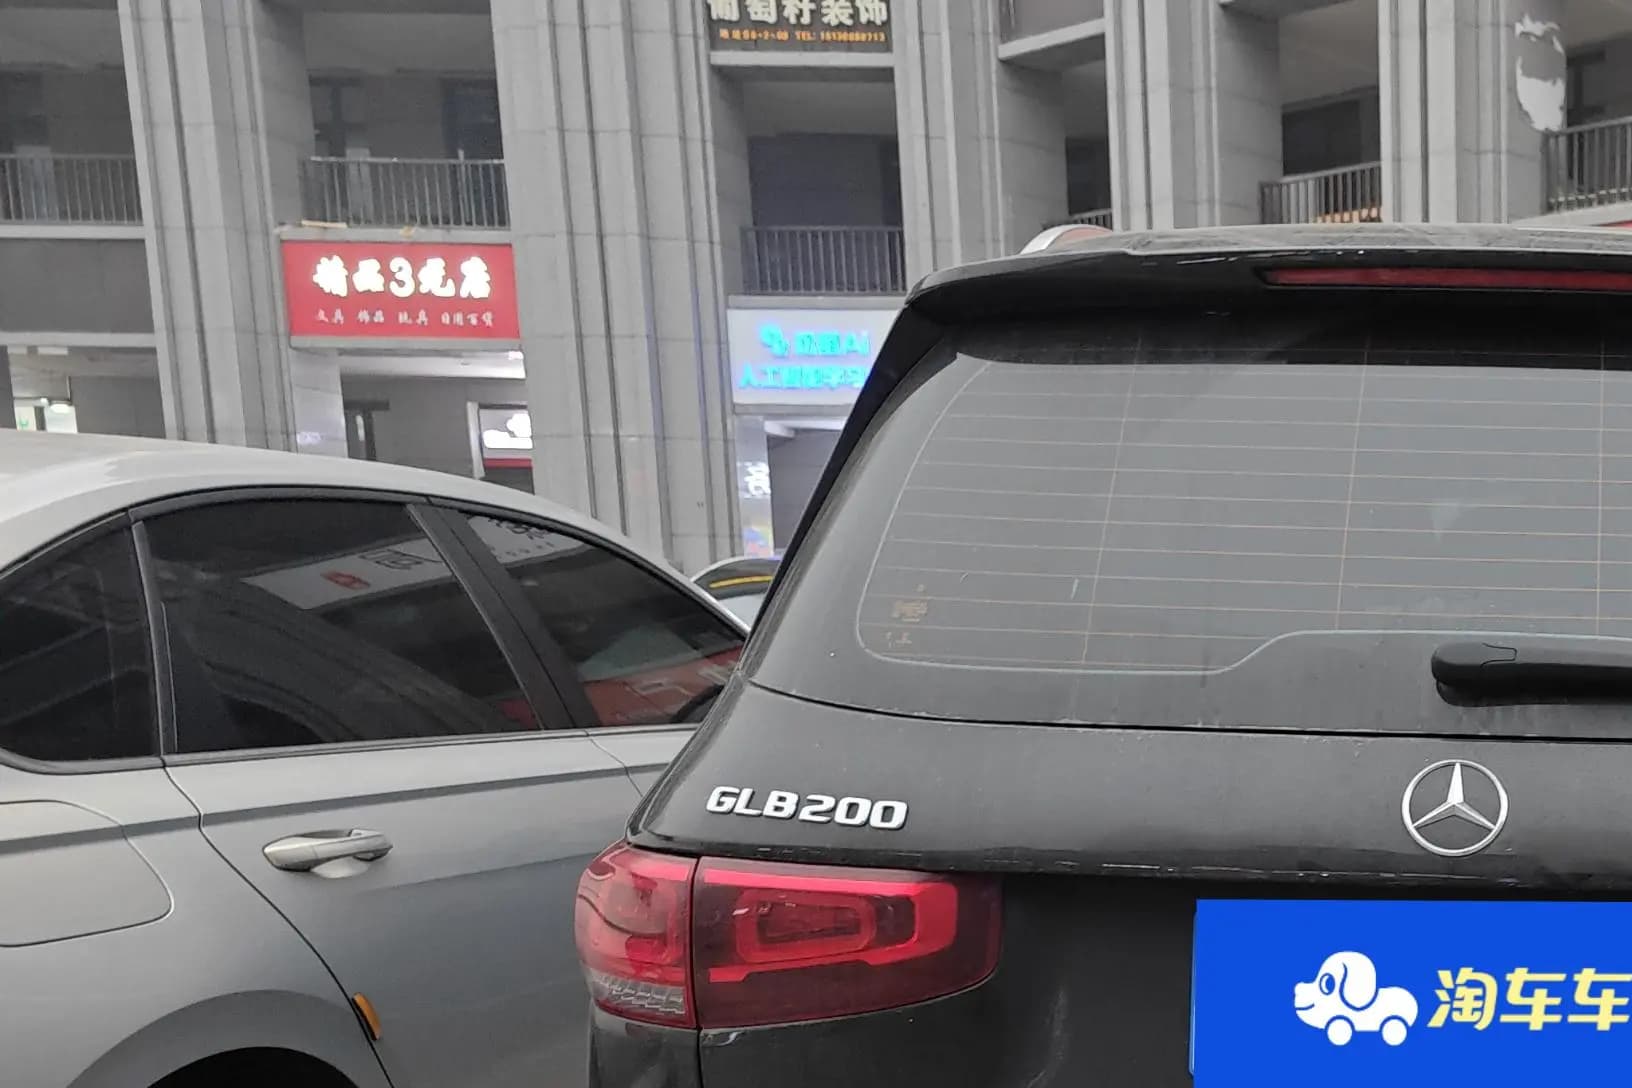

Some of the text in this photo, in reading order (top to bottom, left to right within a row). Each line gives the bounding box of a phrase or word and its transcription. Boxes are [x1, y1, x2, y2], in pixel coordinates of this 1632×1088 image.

[312, 255, 491, 298] 精品3元店
[706, 786, 908, 830] GLB200
